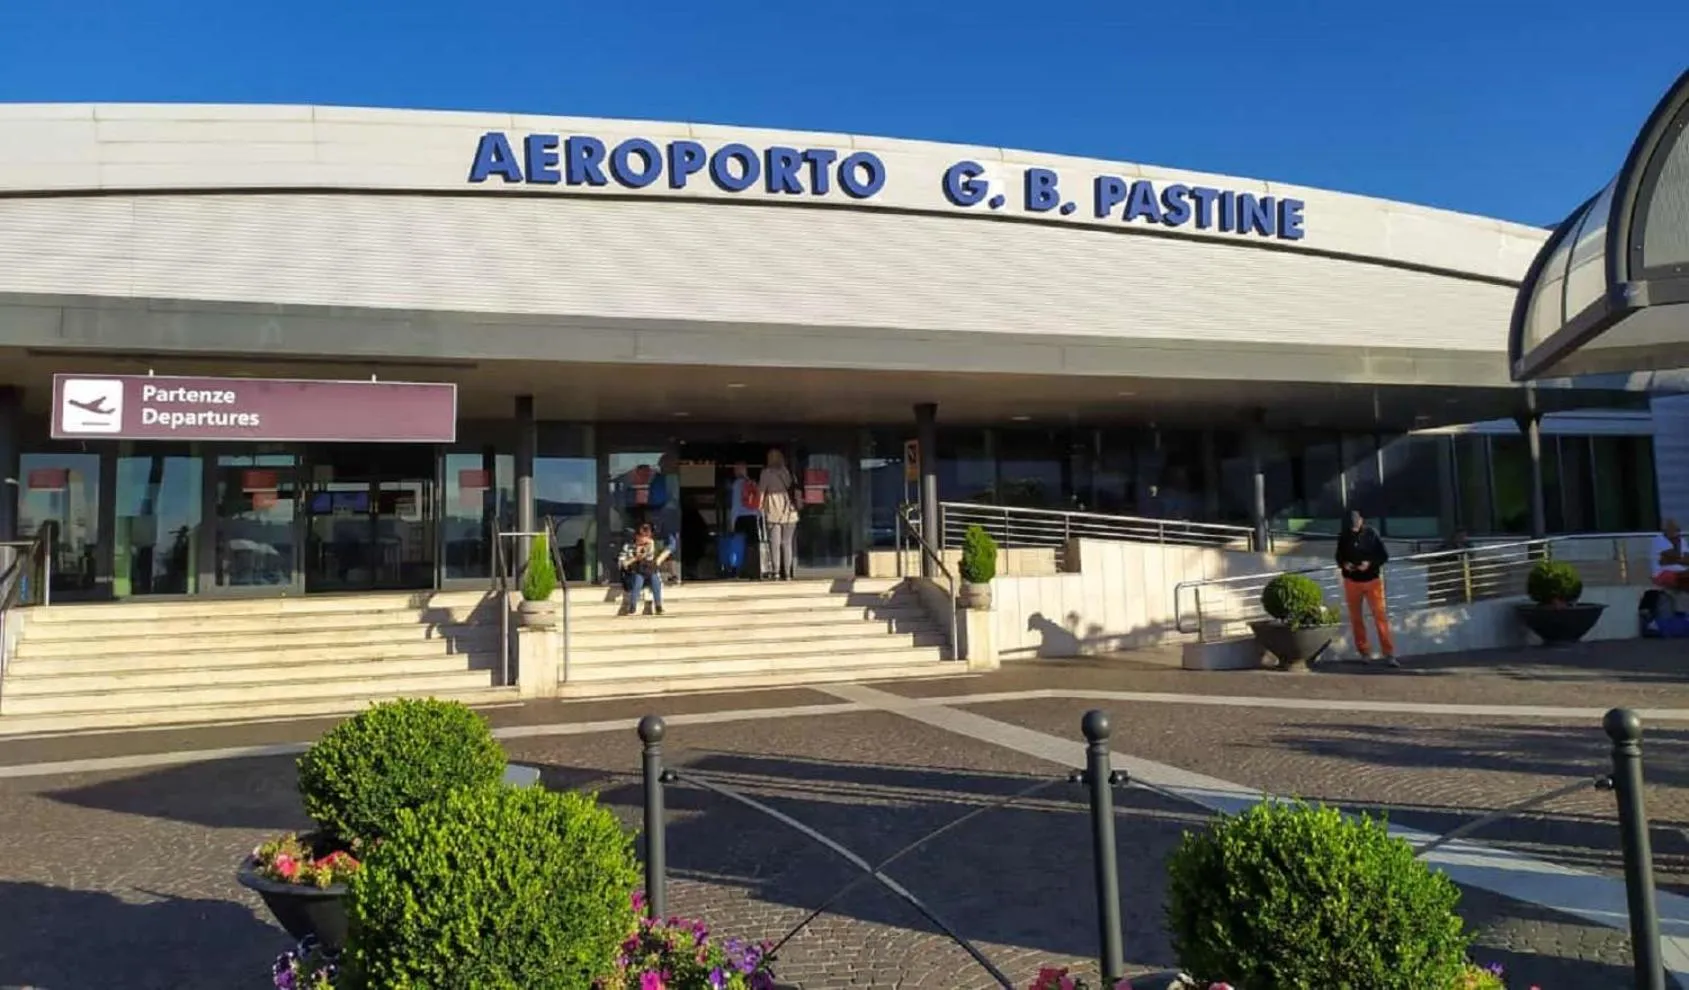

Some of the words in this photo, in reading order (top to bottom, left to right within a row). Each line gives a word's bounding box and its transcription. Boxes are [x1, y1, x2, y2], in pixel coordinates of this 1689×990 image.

[468, 132, 886, 199] AEROPORTO
[943, 160, 1005, 209] G.
[1024, 167, 1076, 215] B.
[1094, 175, 1305, 240] PASTINE
[142, 385, 236, 404] Partenze
[142, 408, 260, 429] Departures
